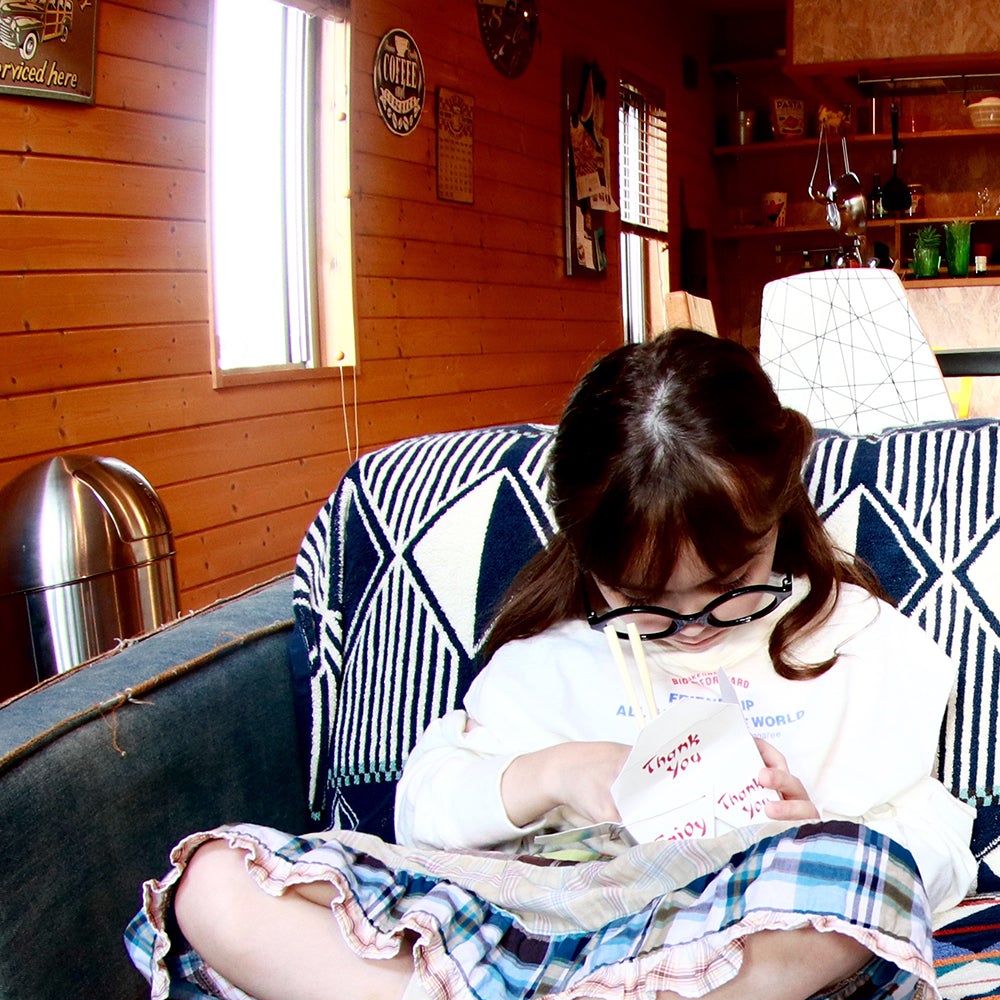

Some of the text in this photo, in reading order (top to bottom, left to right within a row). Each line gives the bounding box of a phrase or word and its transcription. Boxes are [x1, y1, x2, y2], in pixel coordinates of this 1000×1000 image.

[0, 60, 78, 88] rviced here
[383, 53, 418, 89] COFFEE
[751, 710, 805, 728] WORLD
[642, 734, 700, 774] Thank
[717, 778, 764, 810] Thank
[654, 818, 707, 841] joy
